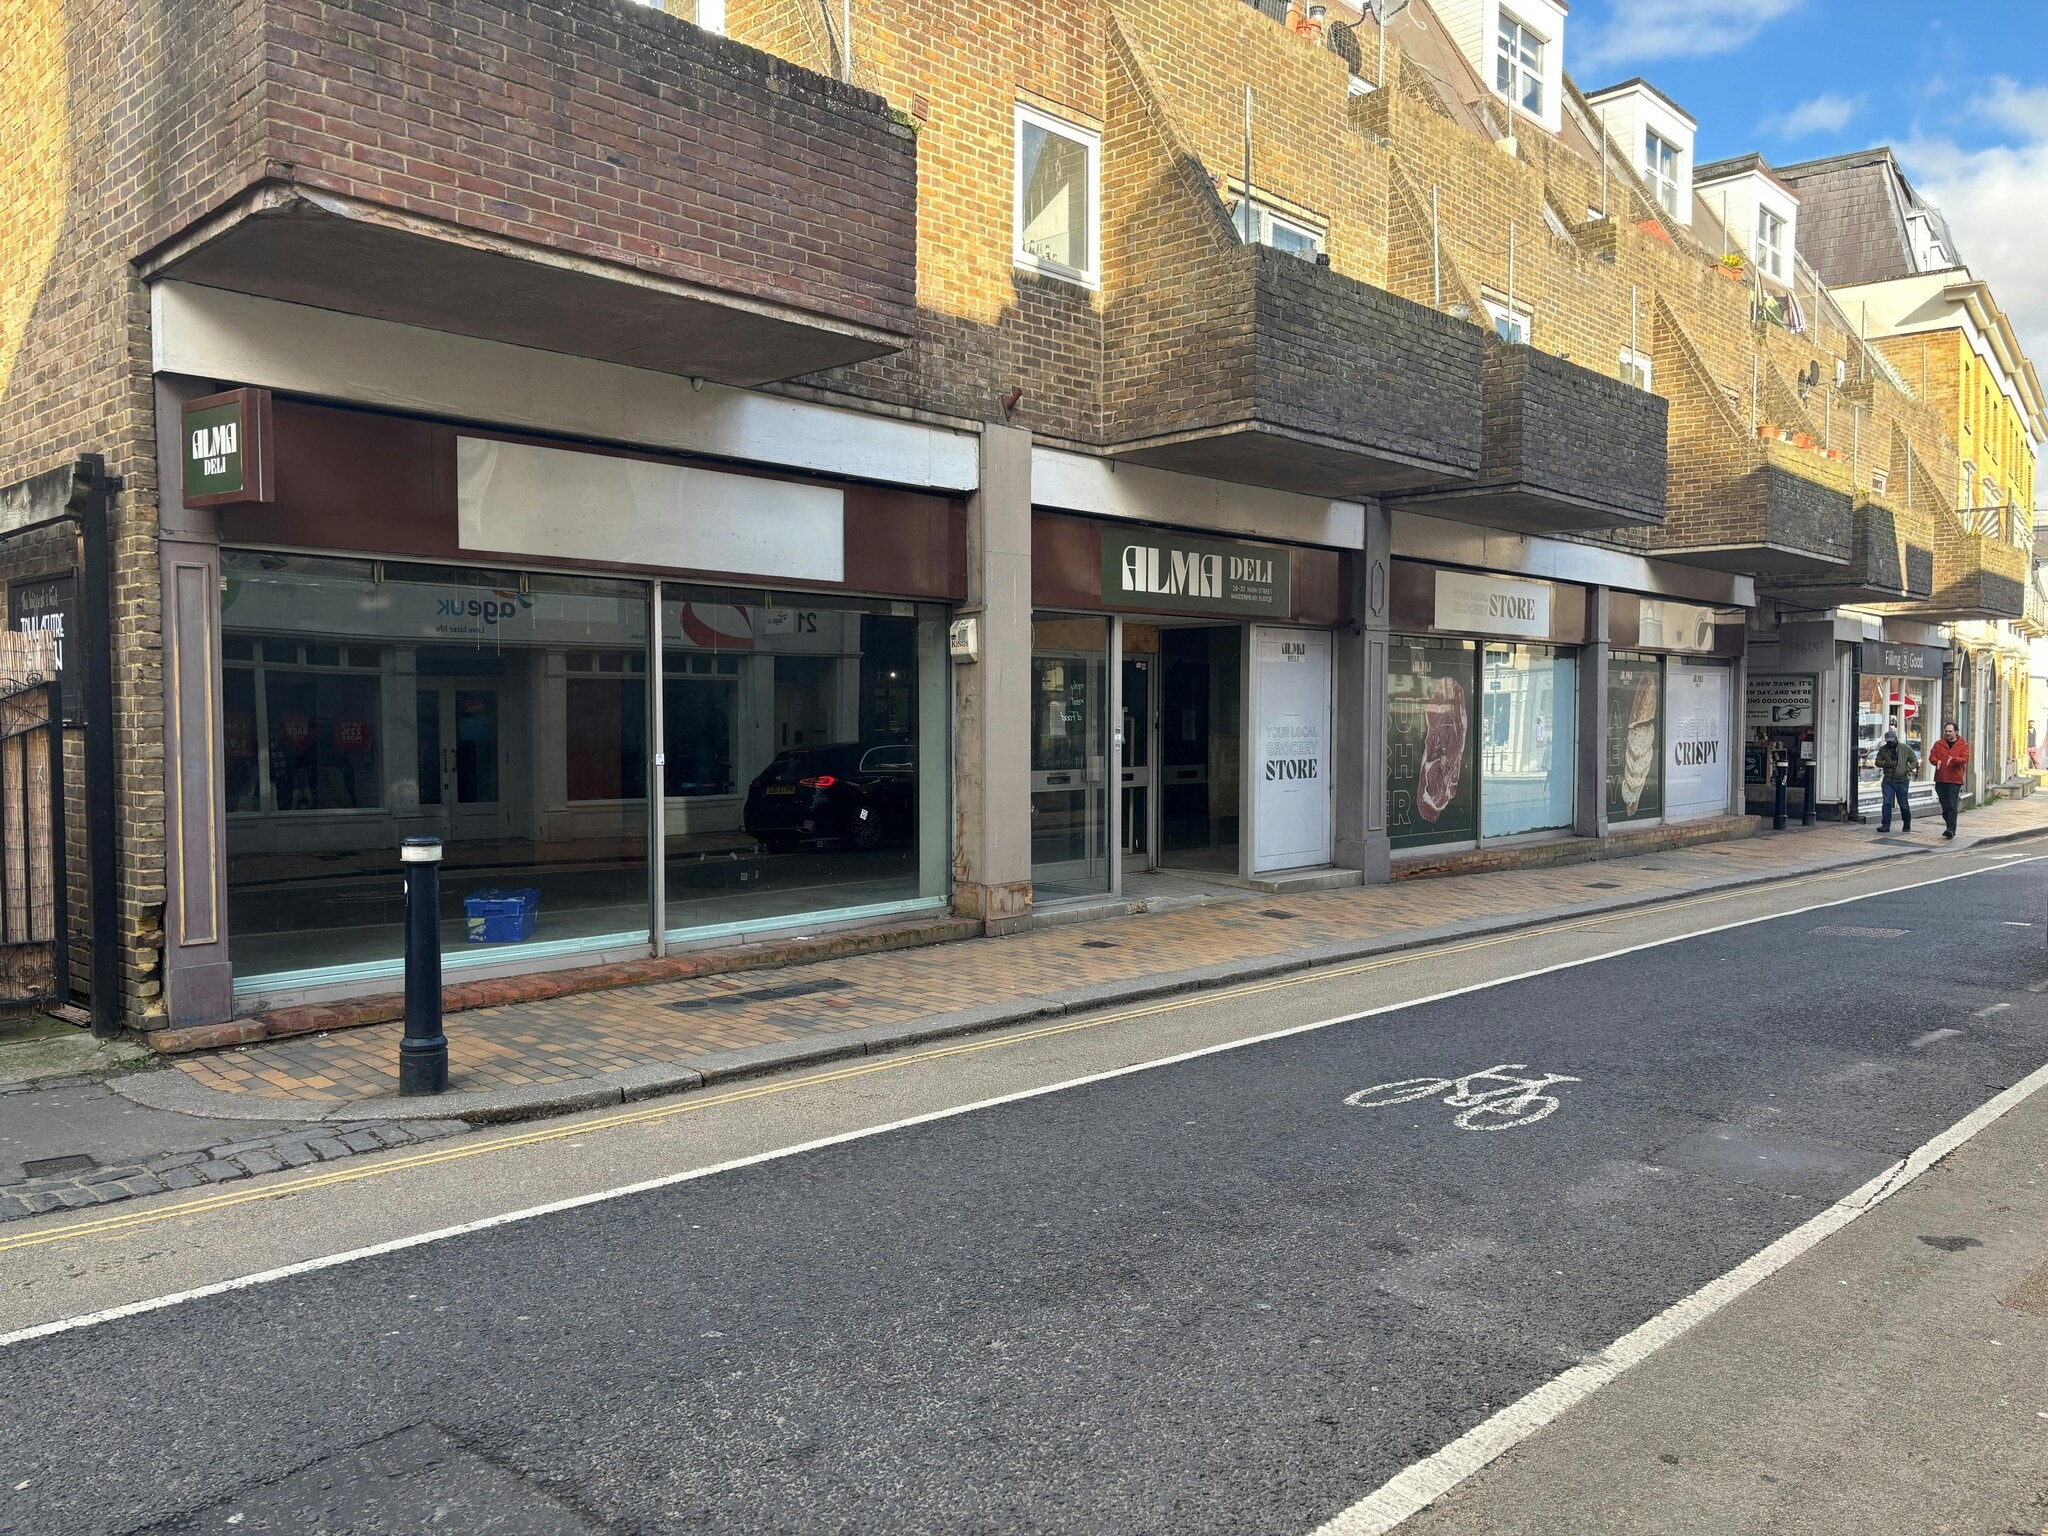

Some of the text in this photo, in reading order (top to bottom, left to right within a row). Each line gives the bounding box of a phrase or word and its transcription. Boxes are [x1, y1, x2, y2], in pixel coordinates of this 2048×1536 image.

[192, 422, 237, 460] ALMA
[204, 456, 226, 476] DELI
[1122, 546, 1272, 598] ALMA DELI
[1490, 594, 1536, 620] STORE
[1282, 642, 1305, 655] ALMA
[1910, 652, 1924, 669] Good
[1266, 726, 1318, 738] YOUR LOCAL
[1266, 741, 1318, 756] GROCERY
[1674, 740, 1718, 766] CRISPY
[1266, 759, 1317, 781] STORE
